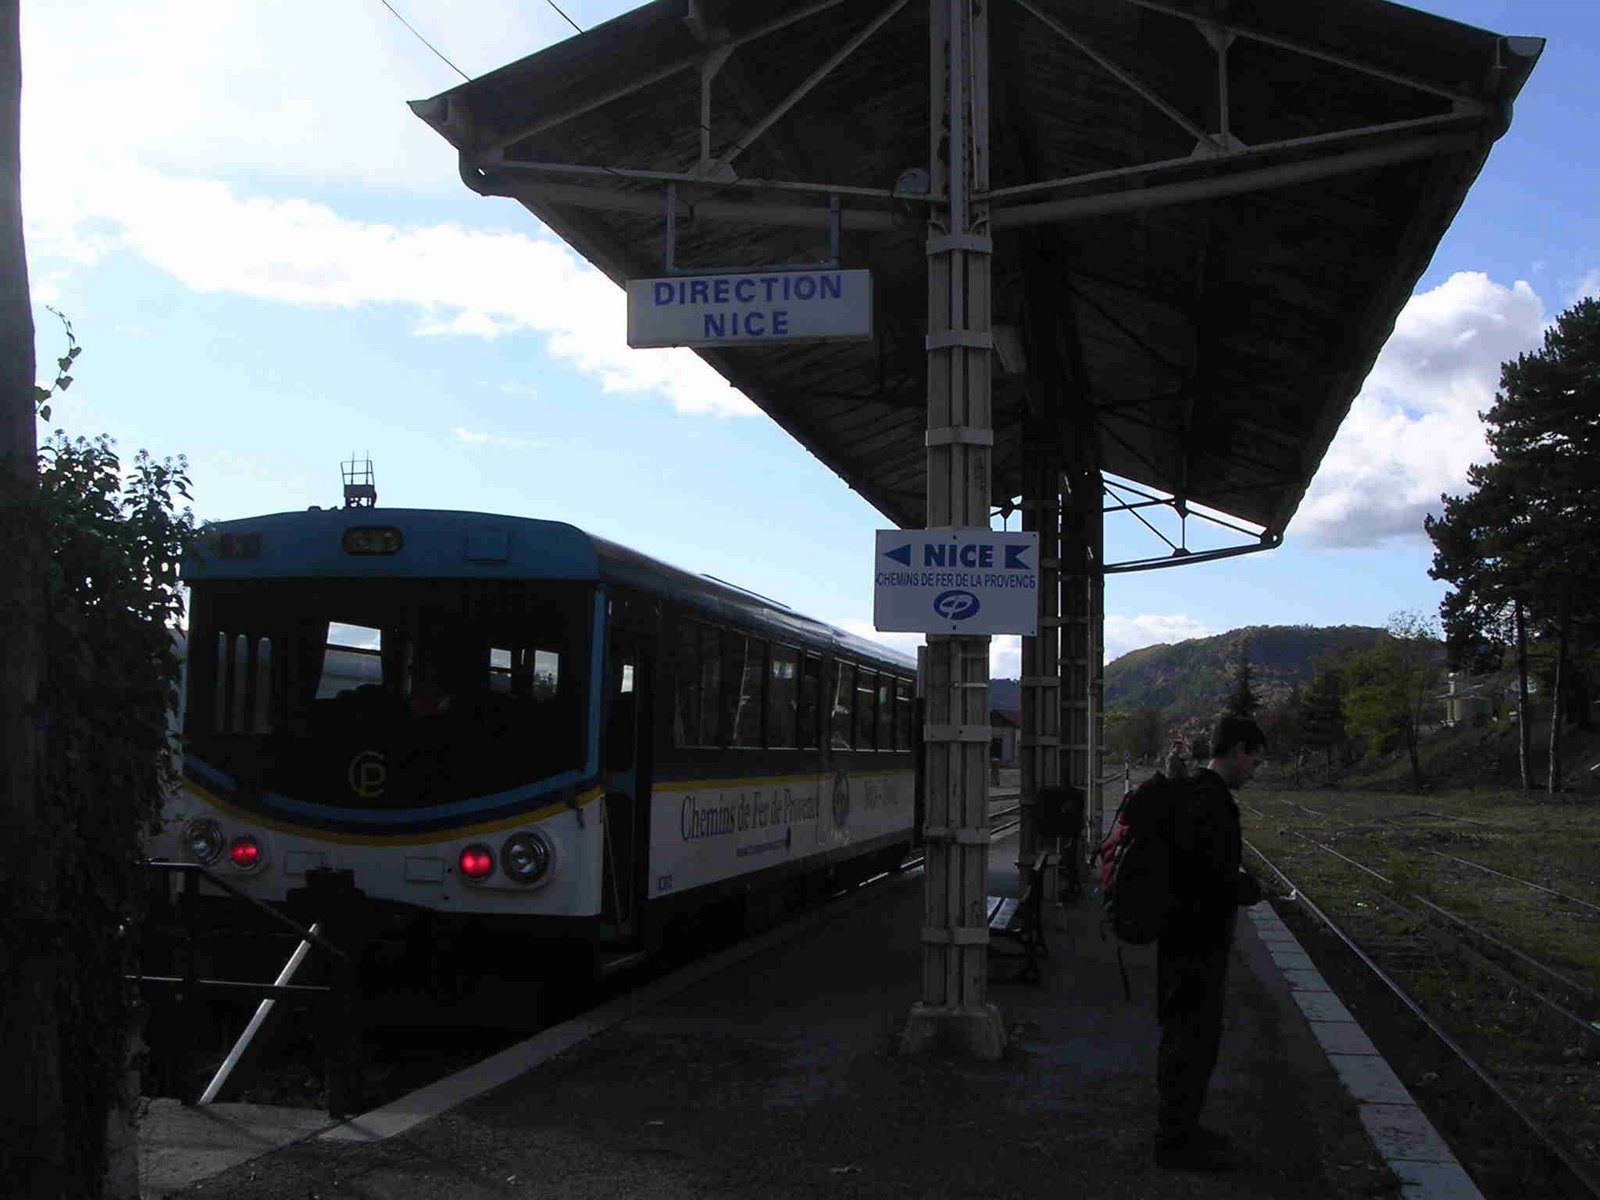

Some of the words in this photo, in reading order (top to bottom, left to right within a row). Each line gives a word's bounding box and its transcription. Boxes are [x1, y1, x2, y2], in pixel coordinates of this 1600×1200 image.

[654, 274, 842, 306] DIRECTION
[704, 311, 789, 338] NICE
[924, 543, 994, 568] NICE
[877, 573, 919, 587] CHEMINS
[921, 573, 934, 587] DE
[935, 573, 954, 588] FER
[956, 574, 969, 588] DE
[971, 575, 982, 588] LA
[681, 793, 736, 841] Chemins
[737, 793, 751, 832] de
